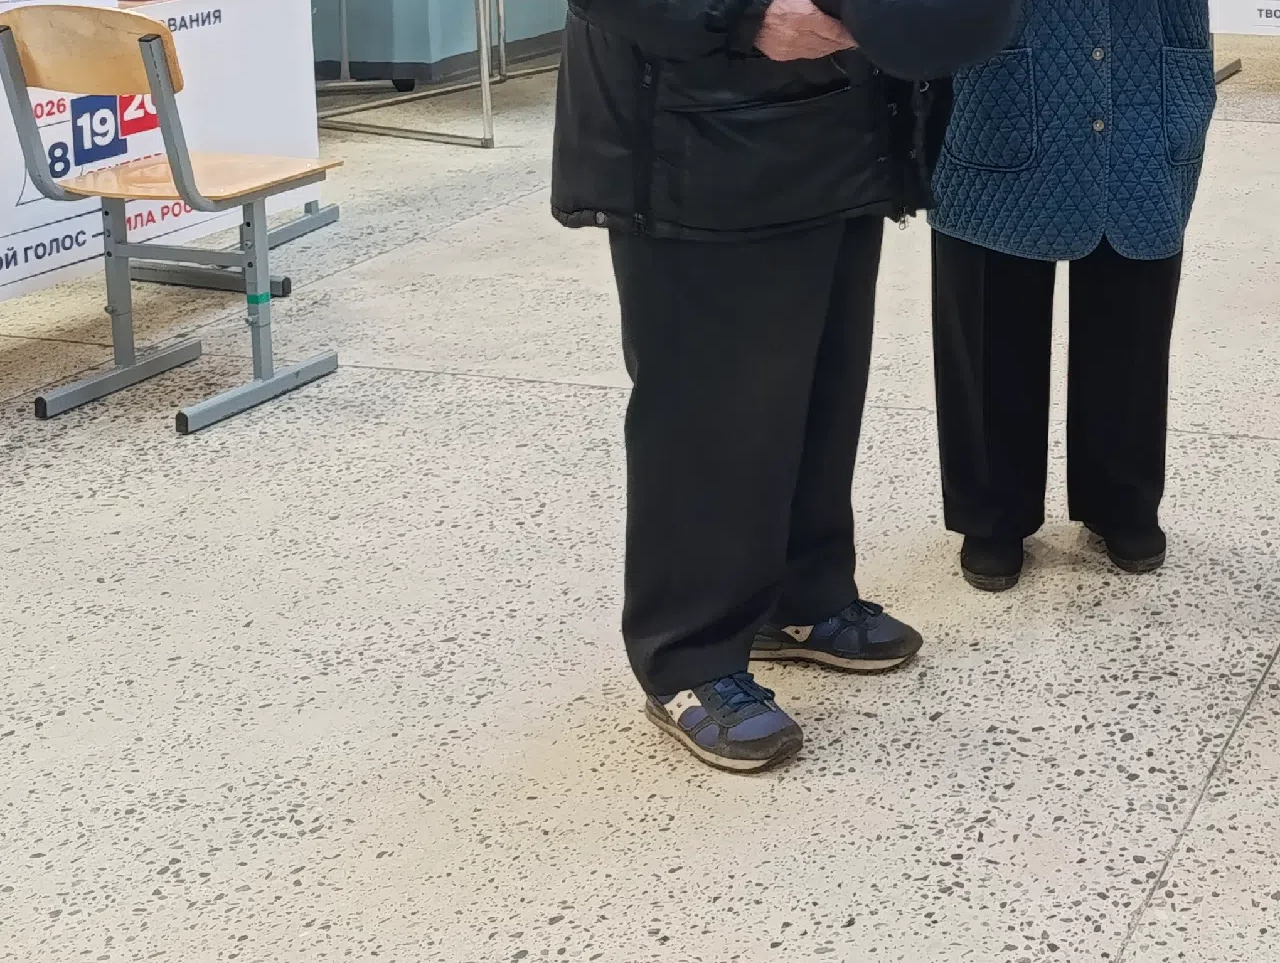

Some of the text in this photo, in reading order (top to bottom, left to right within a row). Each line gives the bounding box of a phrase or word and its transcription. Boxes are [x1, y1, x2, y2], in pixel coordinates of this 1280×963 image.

[162, 9, 222, 32] ВАНИЯ
[48, 141, 71, 178] 8
[76, 108, 116, 150] 19
[23, 229, 87, 264] ГОЛОС
